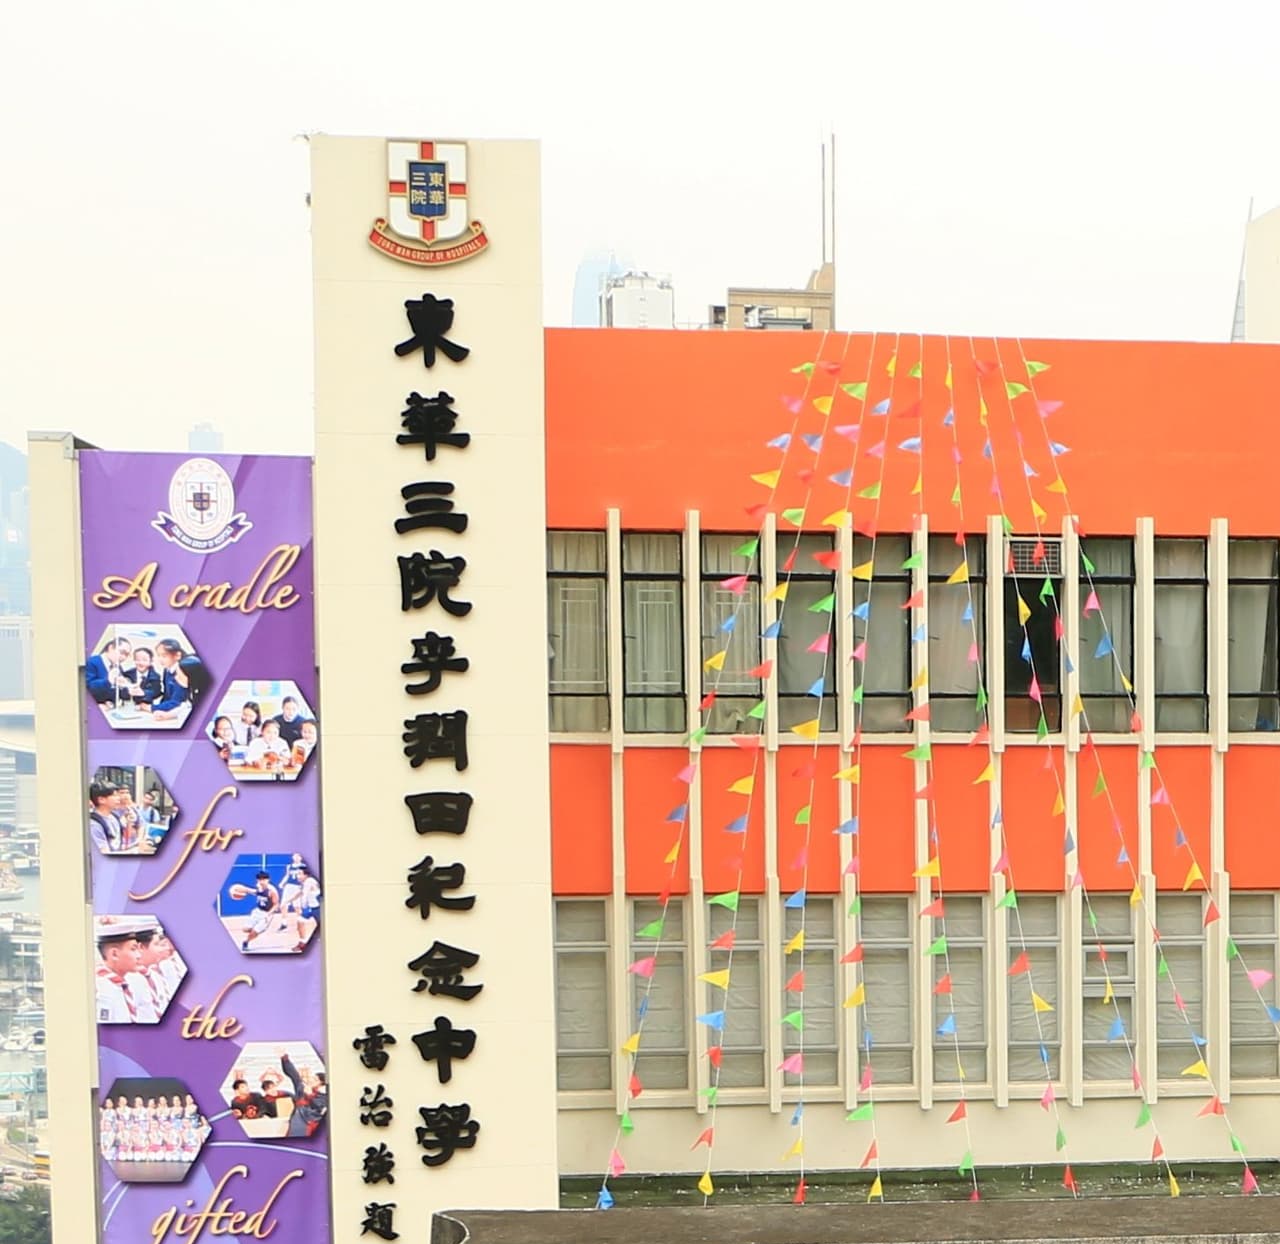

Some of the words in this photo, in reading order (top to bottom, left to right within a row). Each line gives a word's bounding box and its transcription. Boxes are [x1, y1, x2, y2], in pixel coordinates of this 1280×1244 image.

[411, 250, 434, 261] GROUP
[93, 562, 160, 610] A
[169, 544, 301, 614] cradle
[394, 293, 484, 1168] 東華三院李潤田紀念中學
[128, 786, 244, 901] for
[181, 975, 253, 1040] the
